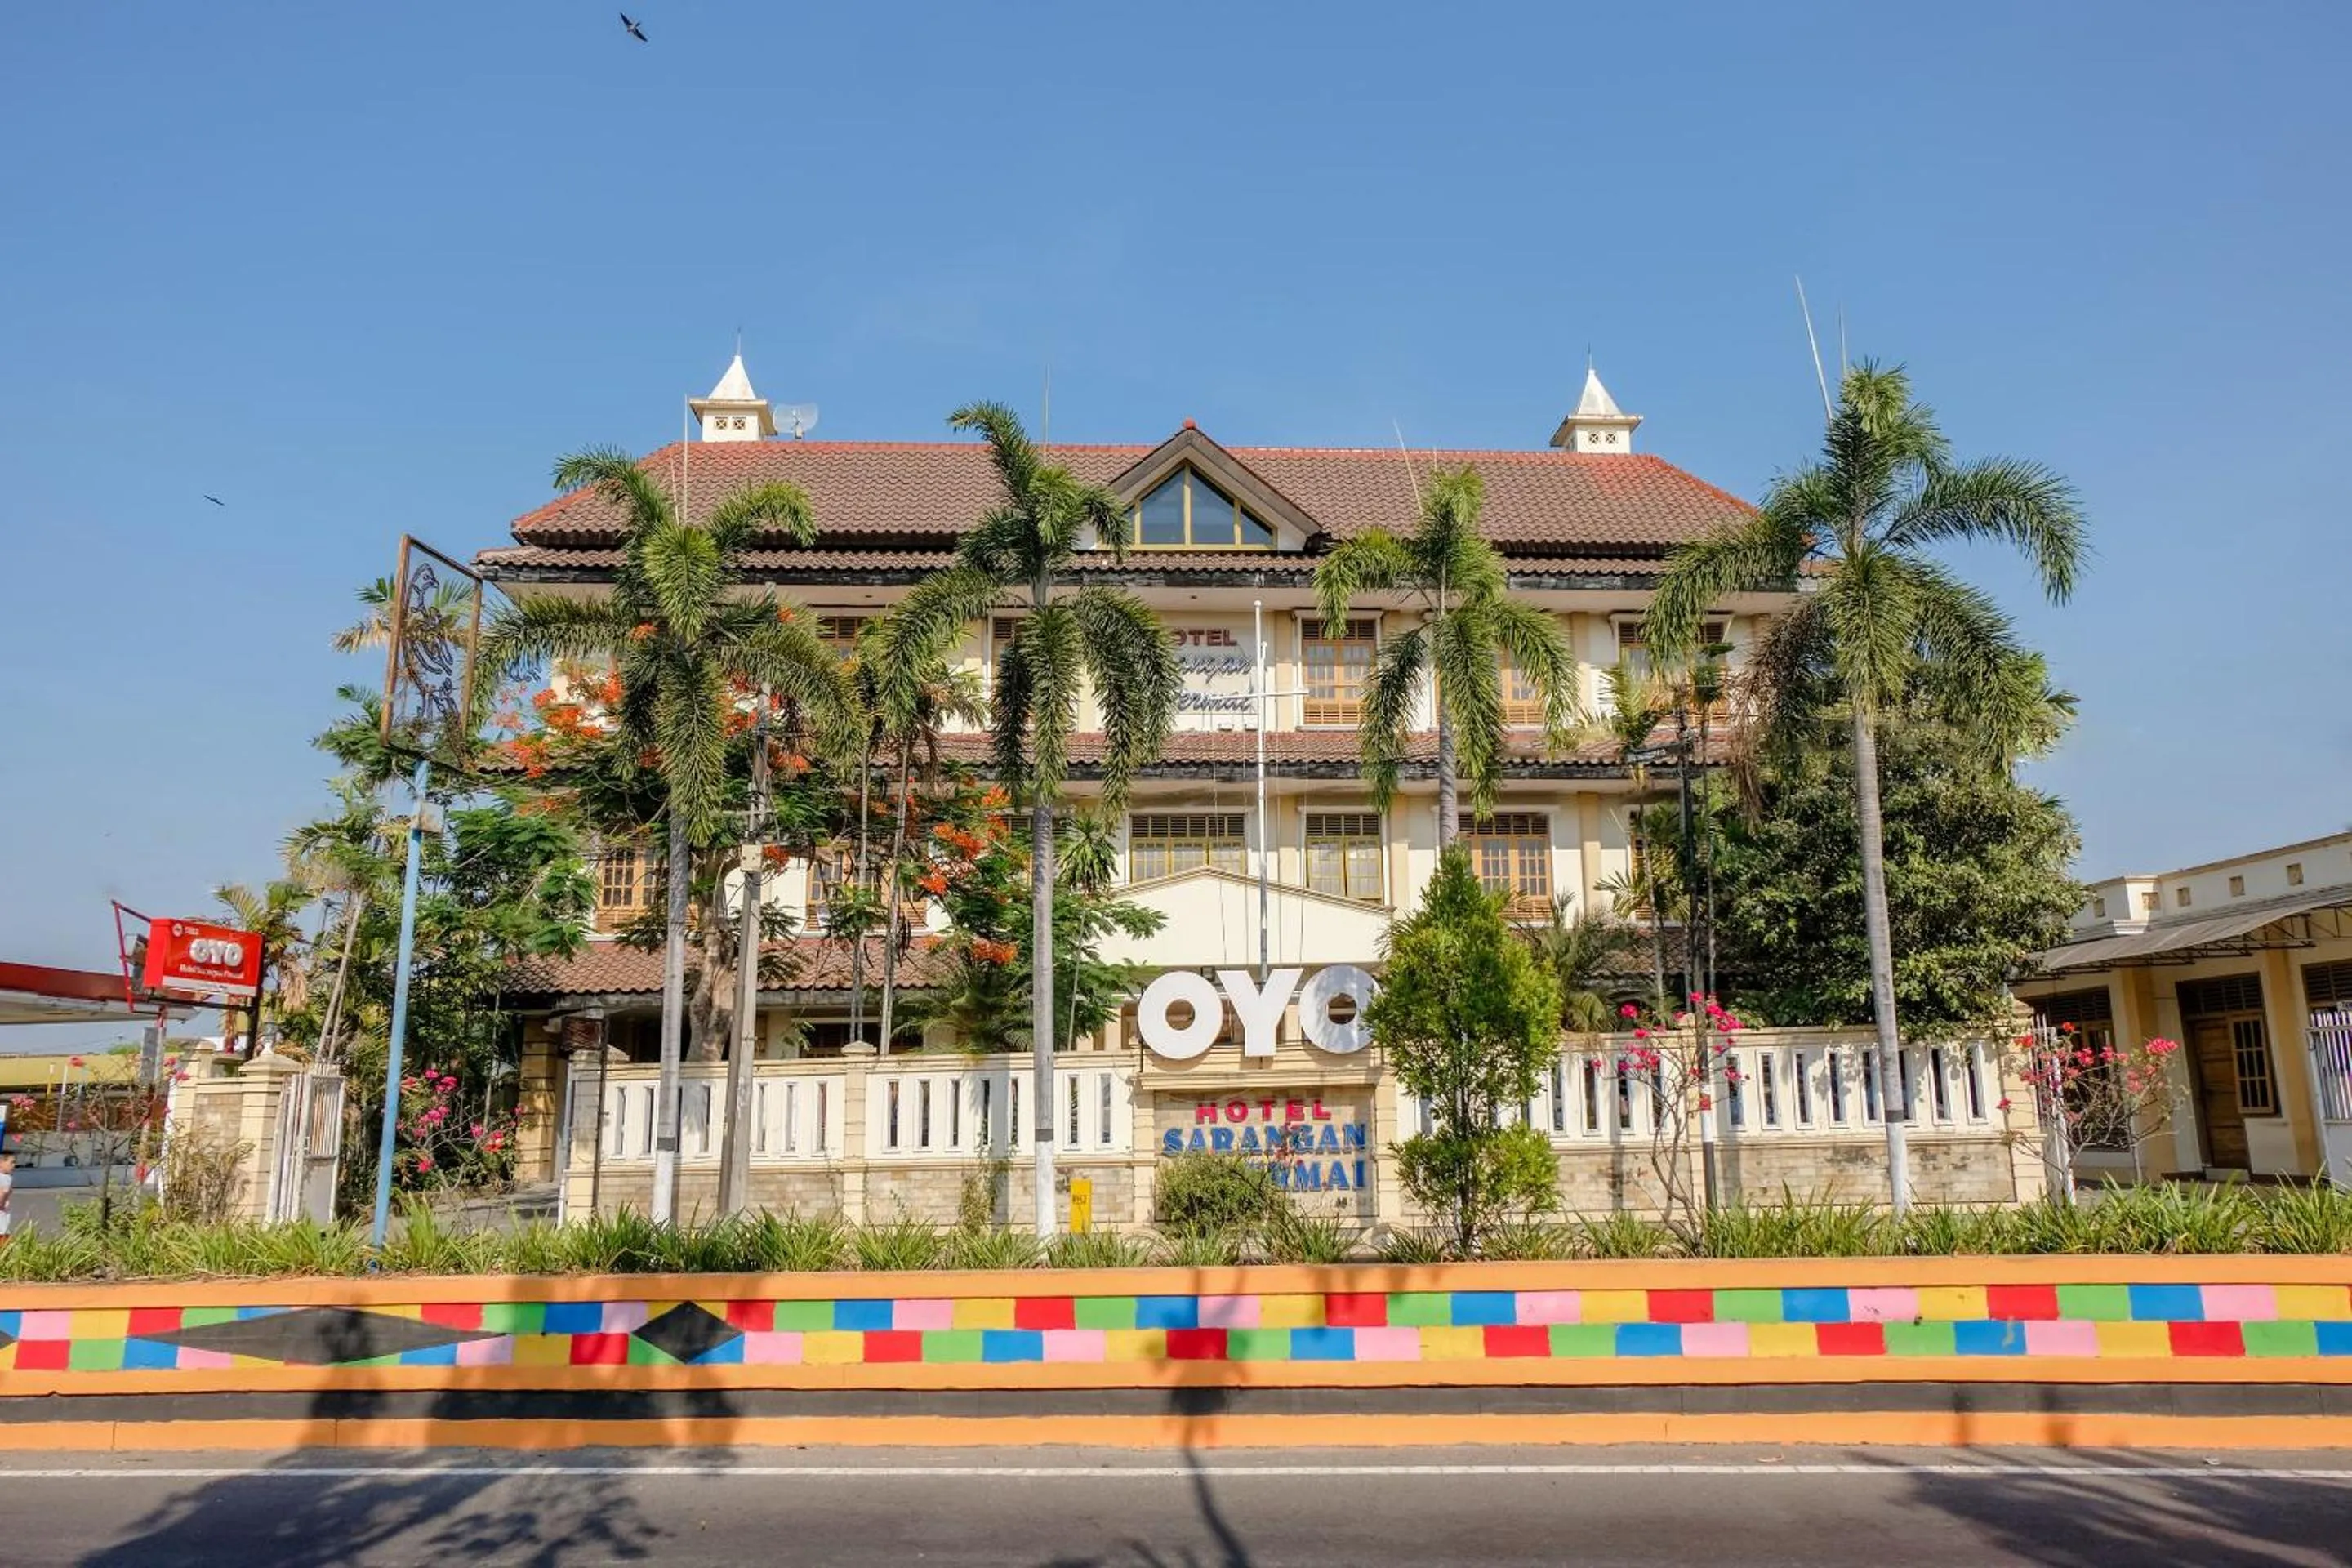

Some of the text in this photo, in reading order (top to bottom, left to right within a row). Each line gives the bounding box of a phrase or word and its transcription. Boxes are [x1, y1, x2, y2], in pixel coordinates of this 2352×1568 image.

[1171, 628, 1237, 647] OTEL
[189, 938, 243, 967] OYO
[1138, 965, 1382, 1060] OYO
[1194, 1098, 1332, 1125] HOTEL
[1161, 1123, 1367, 1156] SARANGAN
[1268, 1159, 1365, 1192] RMAI
